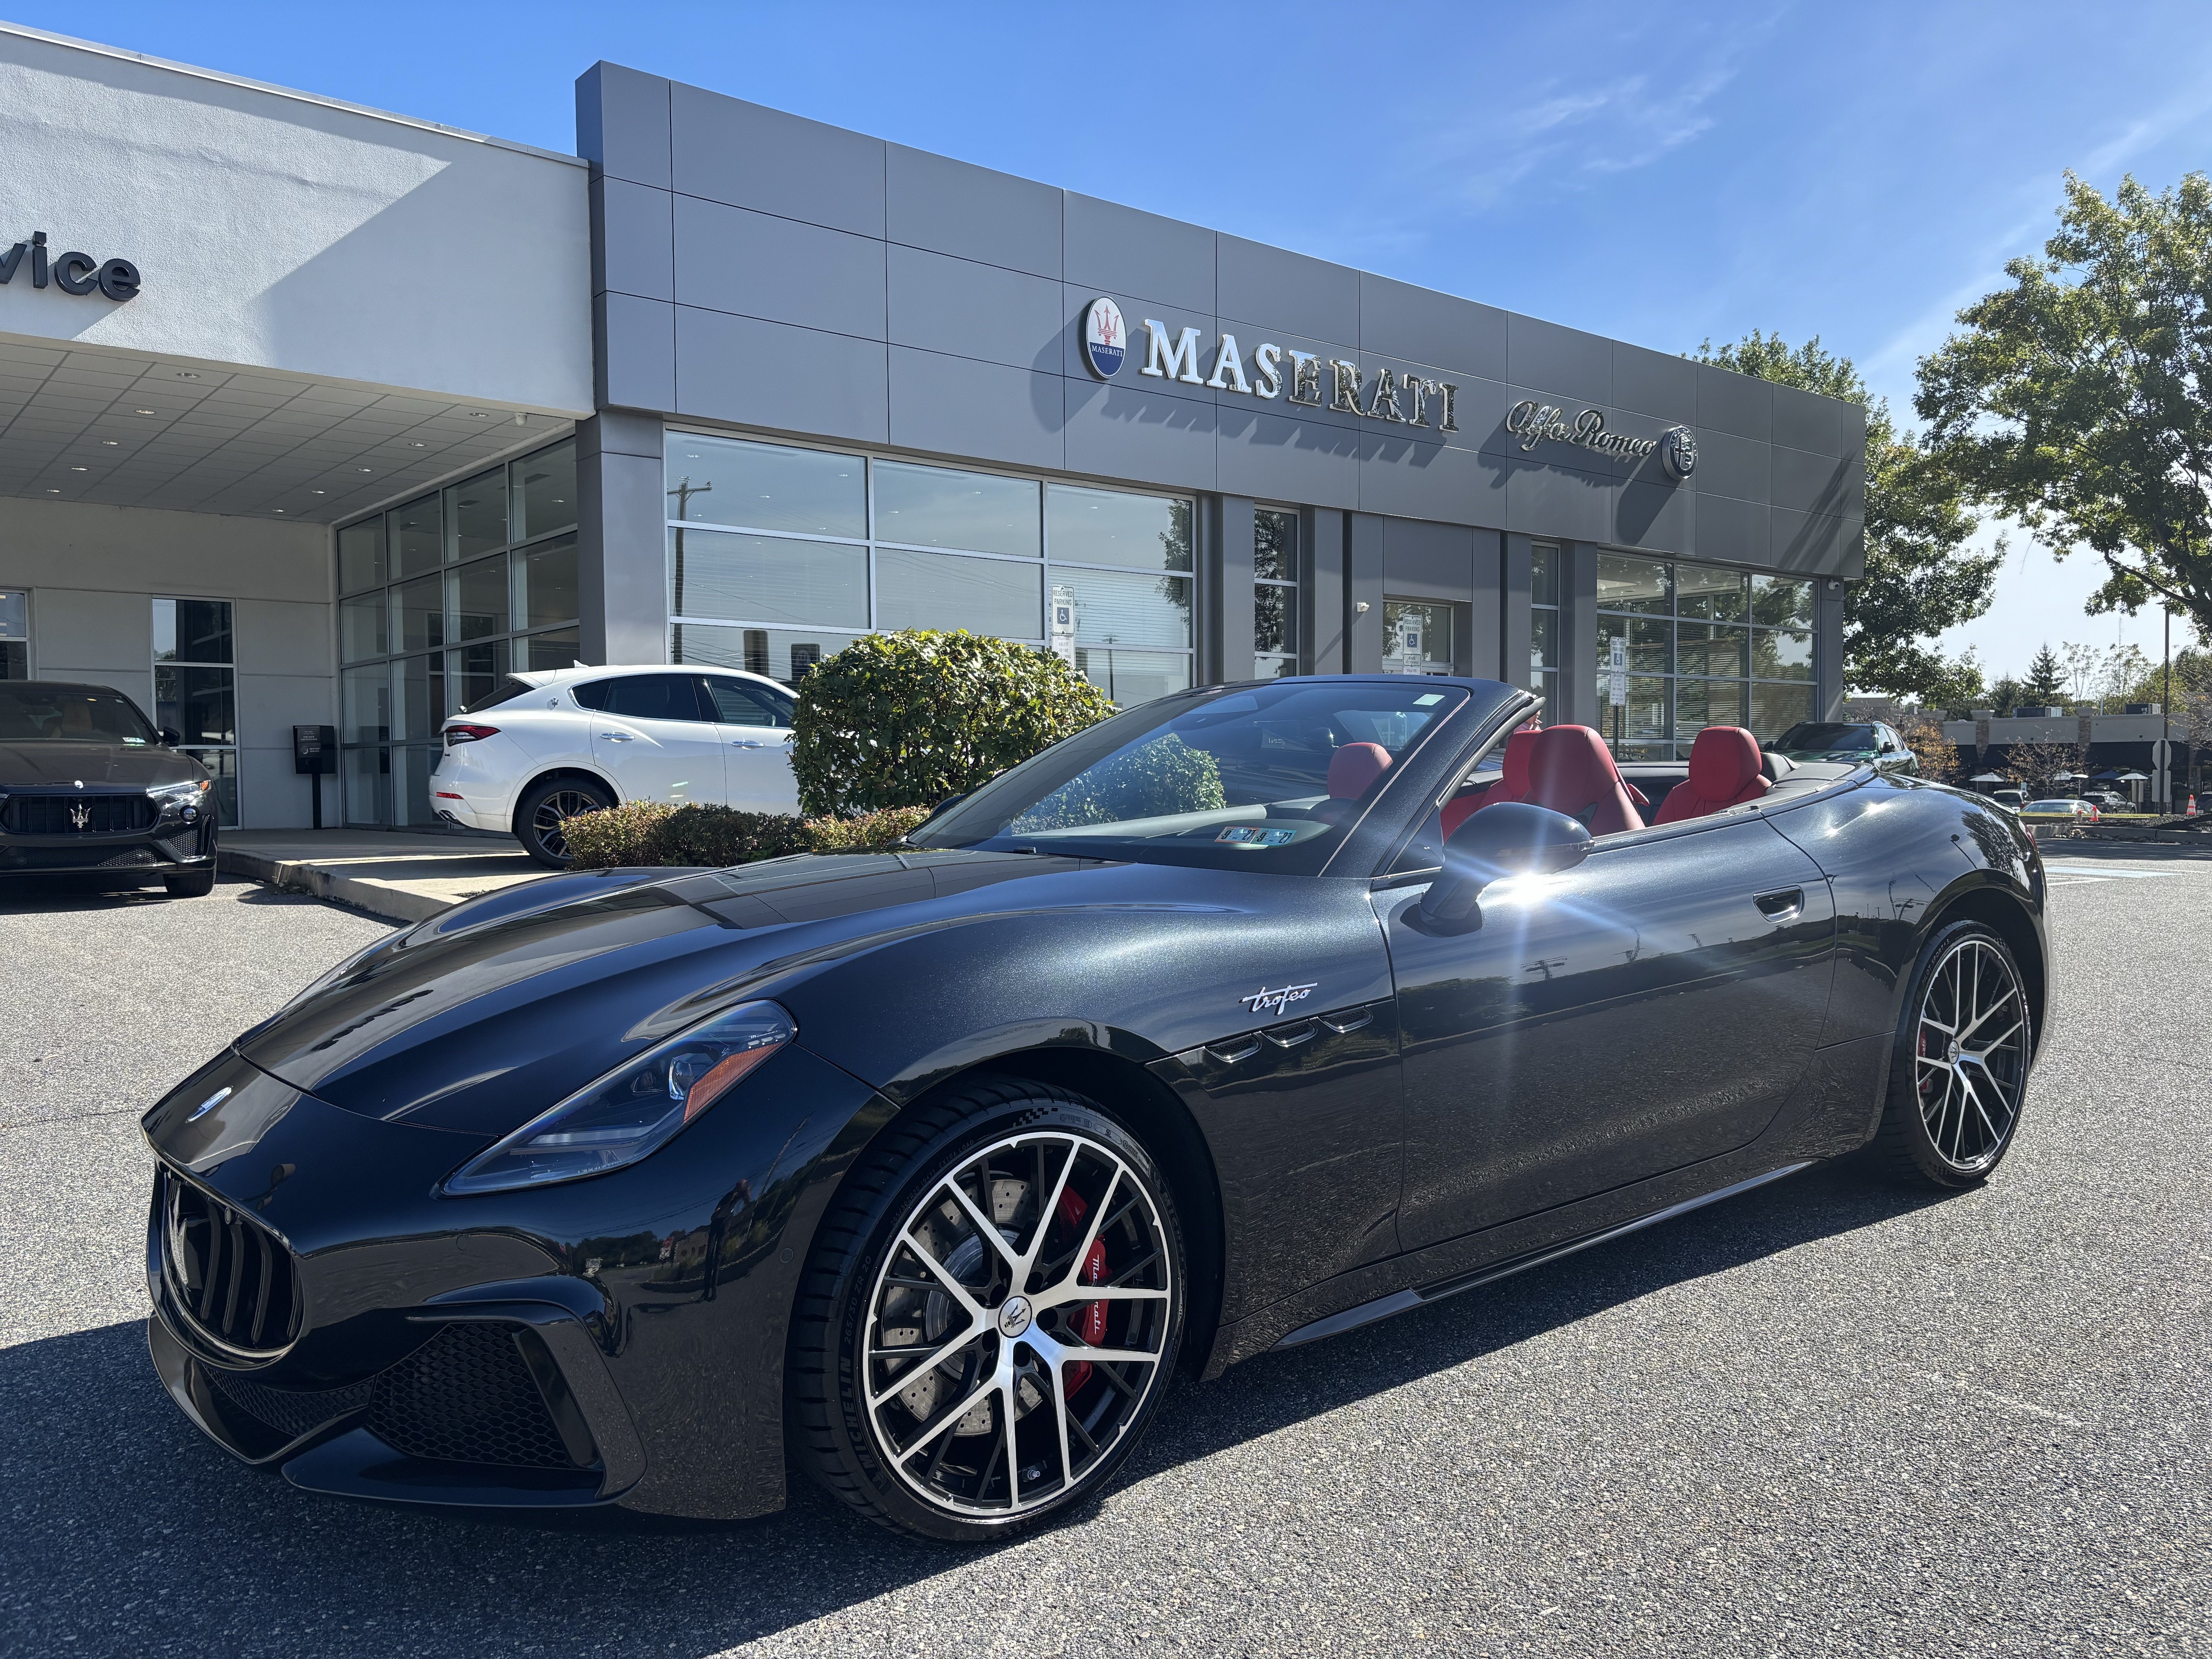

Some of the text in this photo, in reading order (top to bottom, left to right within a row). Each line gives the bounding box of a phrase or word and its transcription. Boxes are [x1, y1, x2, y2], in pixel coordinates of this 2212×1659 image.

[1091, 345, 1123, 357] MASERATI
[1141, 319, 1459, 432] MASERATI
[1506, 400, 1571, 451] Alfa
[1569, 409, 1658, 457] Romeo
[1242, 830, 1257, 841] 27
[1278, 832, 1293, 844] 27
[1931, 945, 1944, 965] SPORT
[1242, 982, 1317, 1015] trofeo
[939, 1151, 958, 1168] EXTRA
[958, 1140, 974, 1153] LOAD
[844, 1255, 871, 1345] 265/30 ZR 20
[1092, 1254, 1101, 1334] Marati
[840, 1357, 877, 1469] MICHELIN
